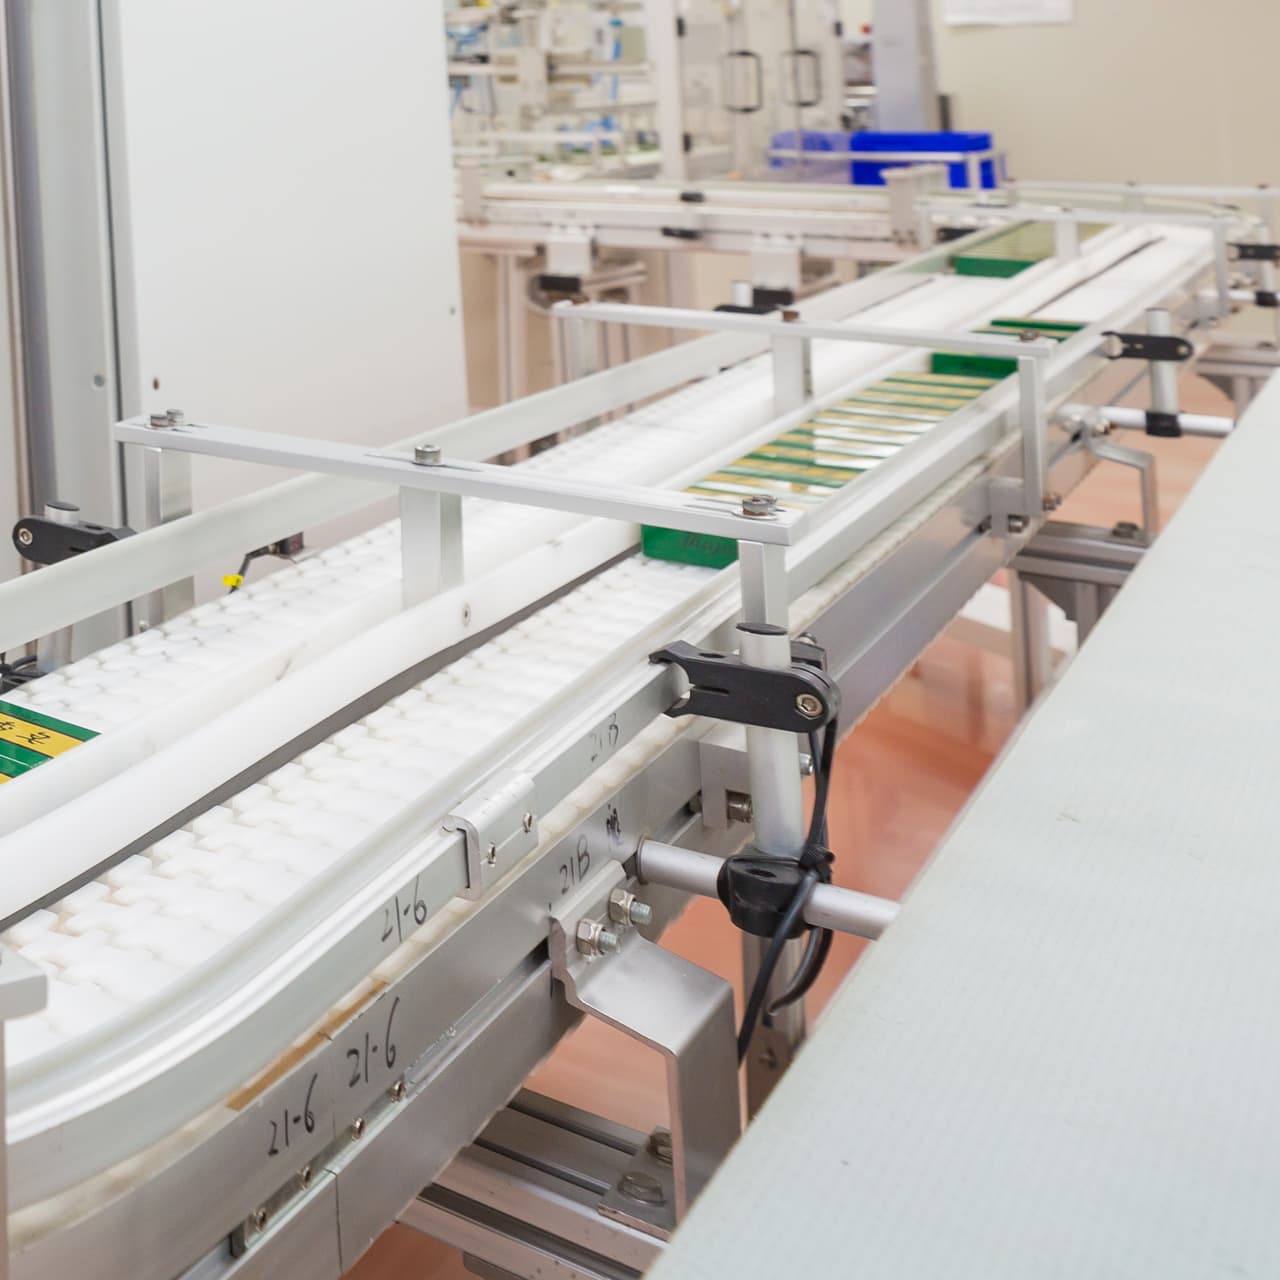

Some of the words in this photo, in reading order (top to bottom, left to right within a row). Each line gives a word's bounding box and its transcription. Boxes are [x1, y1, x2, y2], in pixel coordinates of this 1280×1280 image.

[380, 875, 427, 943] 21-6
[347, 996, 400, 1087] 21-6
[268, 1072, 318, 1156] 21-6
